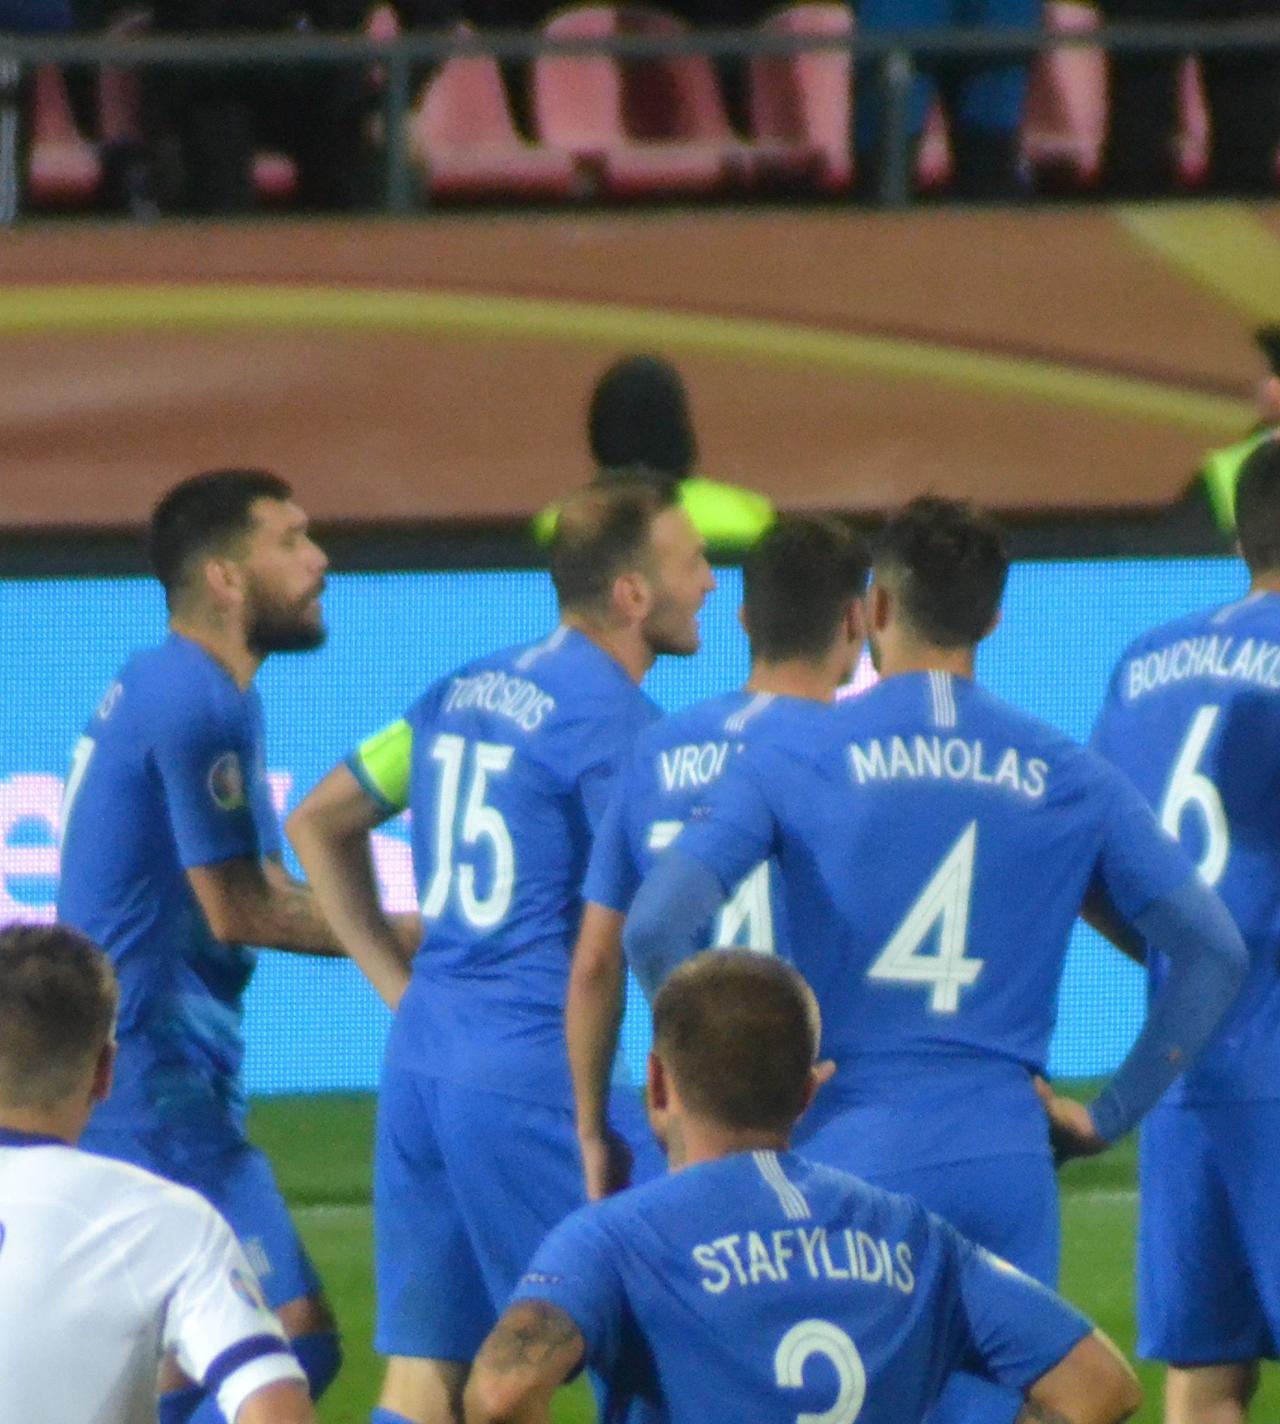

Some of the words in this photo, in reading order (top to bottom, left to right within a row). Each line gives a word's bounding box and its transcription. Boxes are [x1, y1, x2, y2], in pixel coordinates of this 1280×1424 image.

[421, 733, 516, 928] 15
[848, 735, 1048, 800] MANOLAS
[1159, 703, 1229, 888] 6
[866, 818, 983, 1014] 4
[692, 1226, 915, 1295] STAFYLIDIS
